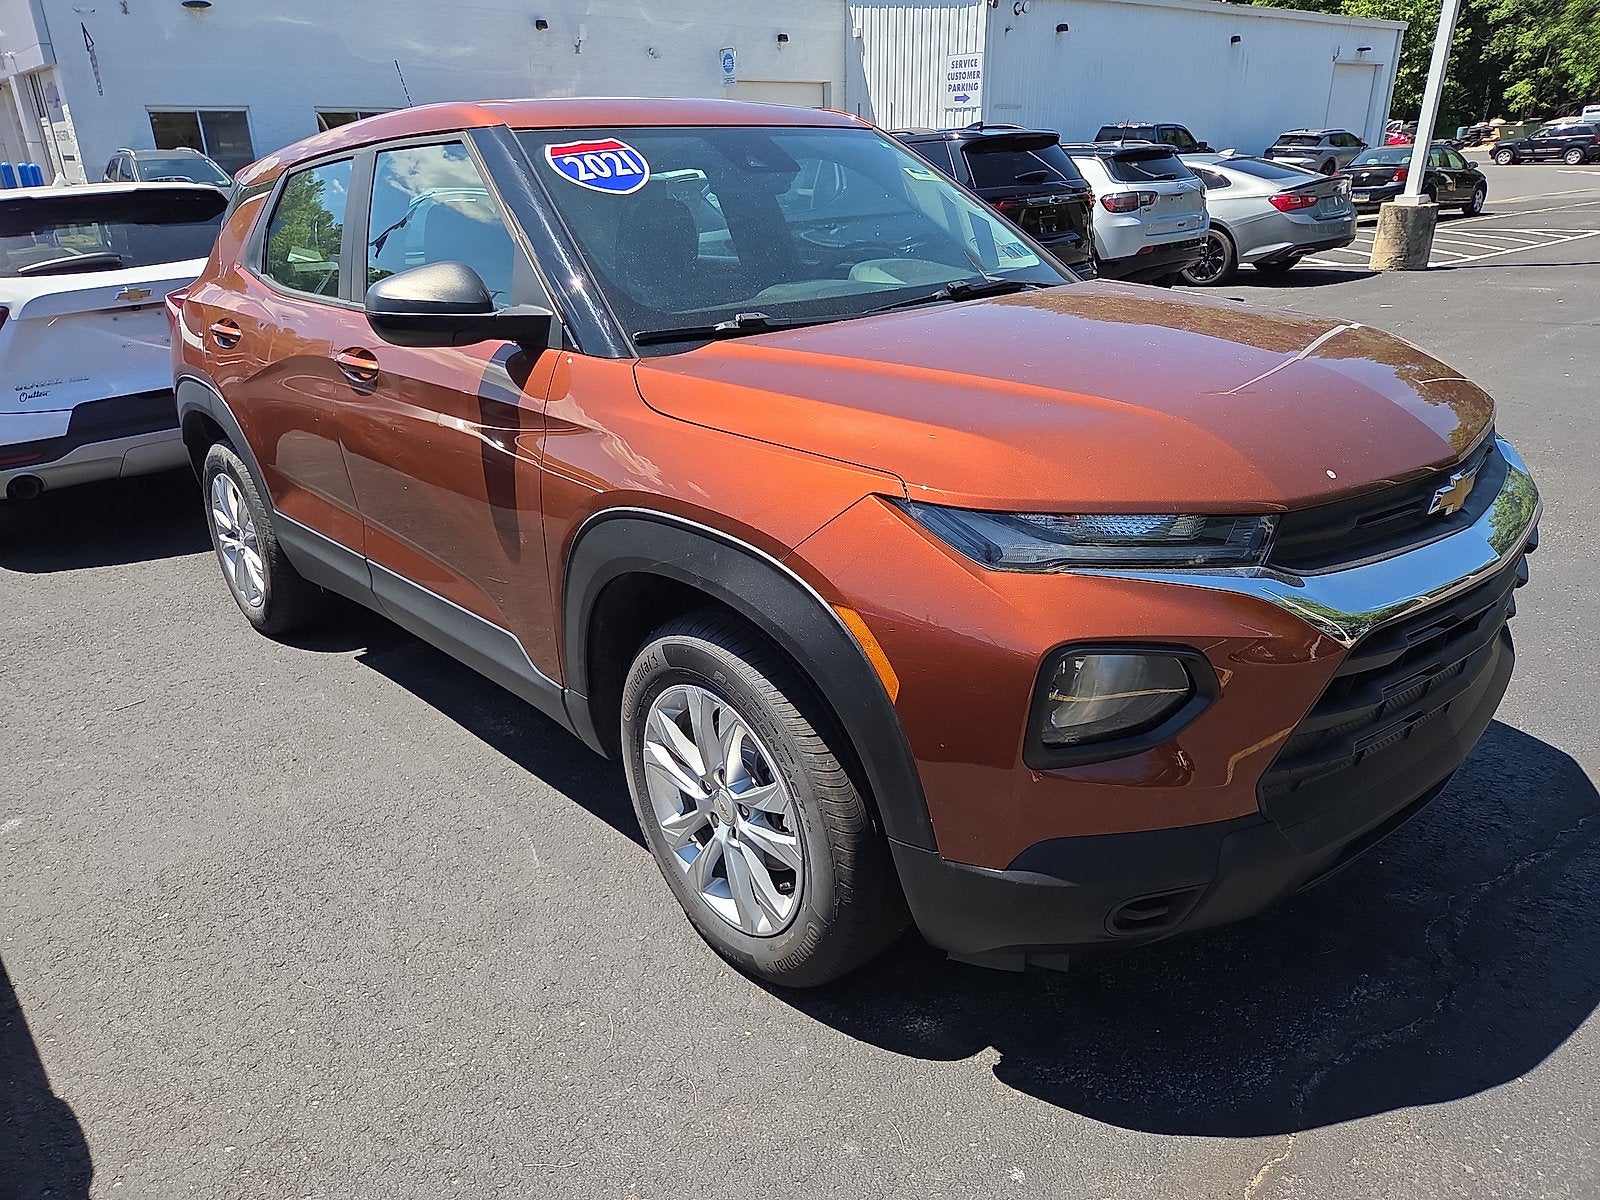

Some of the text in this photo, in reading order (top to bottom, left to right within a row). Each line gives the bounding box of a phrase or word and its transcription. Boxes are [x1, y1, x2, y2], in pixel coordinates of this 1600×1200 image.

[951, 58, 978, 69] SERVICE
[947, 70, 981, 81] CUSTOMER
[947, 82, 979, 92] PARKING
[562, 150, 643, 181] 2021
[774, 920, 820, 973] Continental
